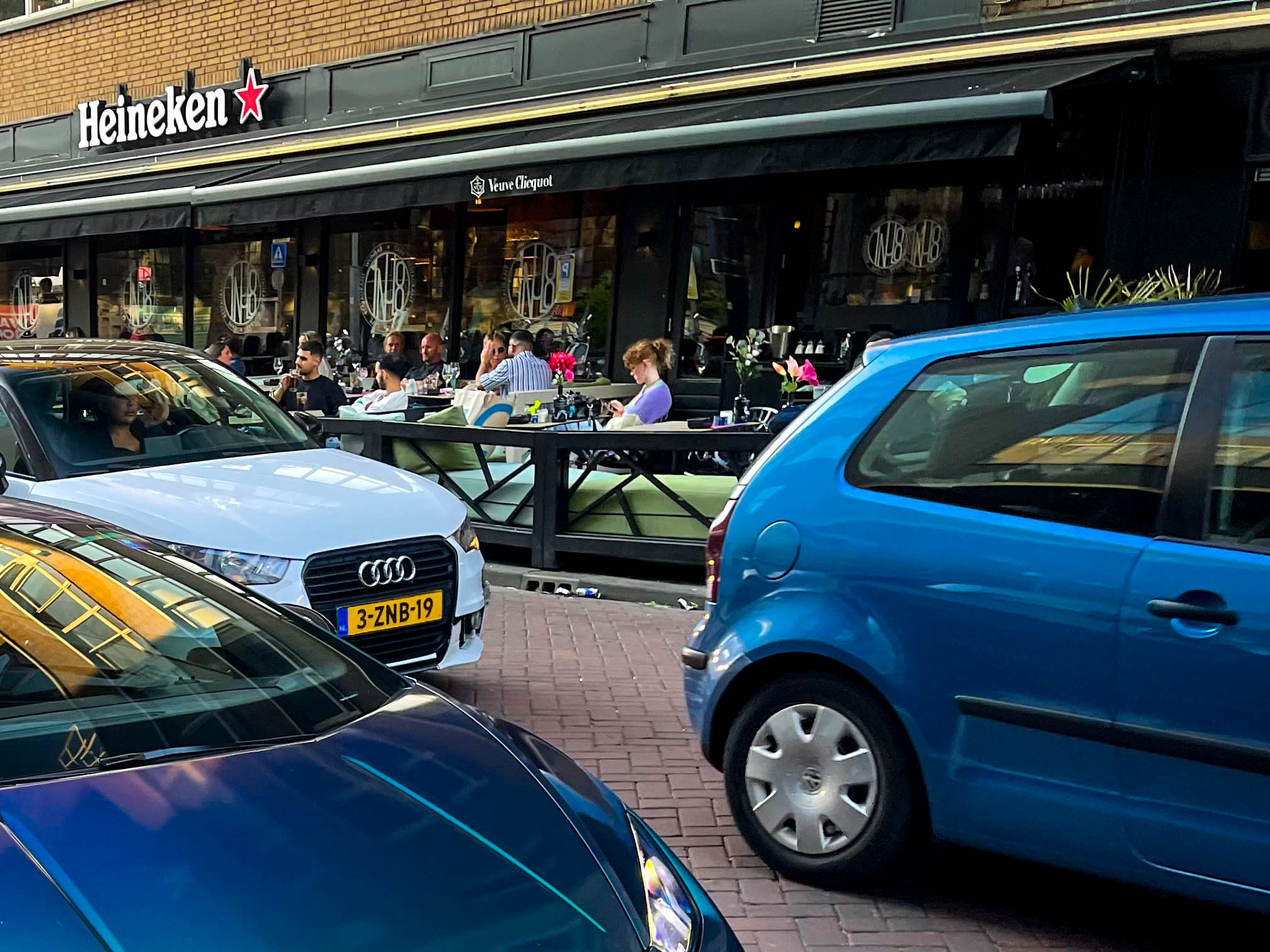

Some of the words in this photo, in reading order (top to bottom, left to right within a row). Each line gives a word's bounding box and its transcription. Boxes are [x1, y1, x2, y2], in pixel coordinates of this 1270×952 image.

[78, 85, 228, 149] Heineken
[488, 178, 514, 192] Veuve
[515, 175, 553, 191] Clicquot
[357, 597, 433, 629] 3-ZNB-19
